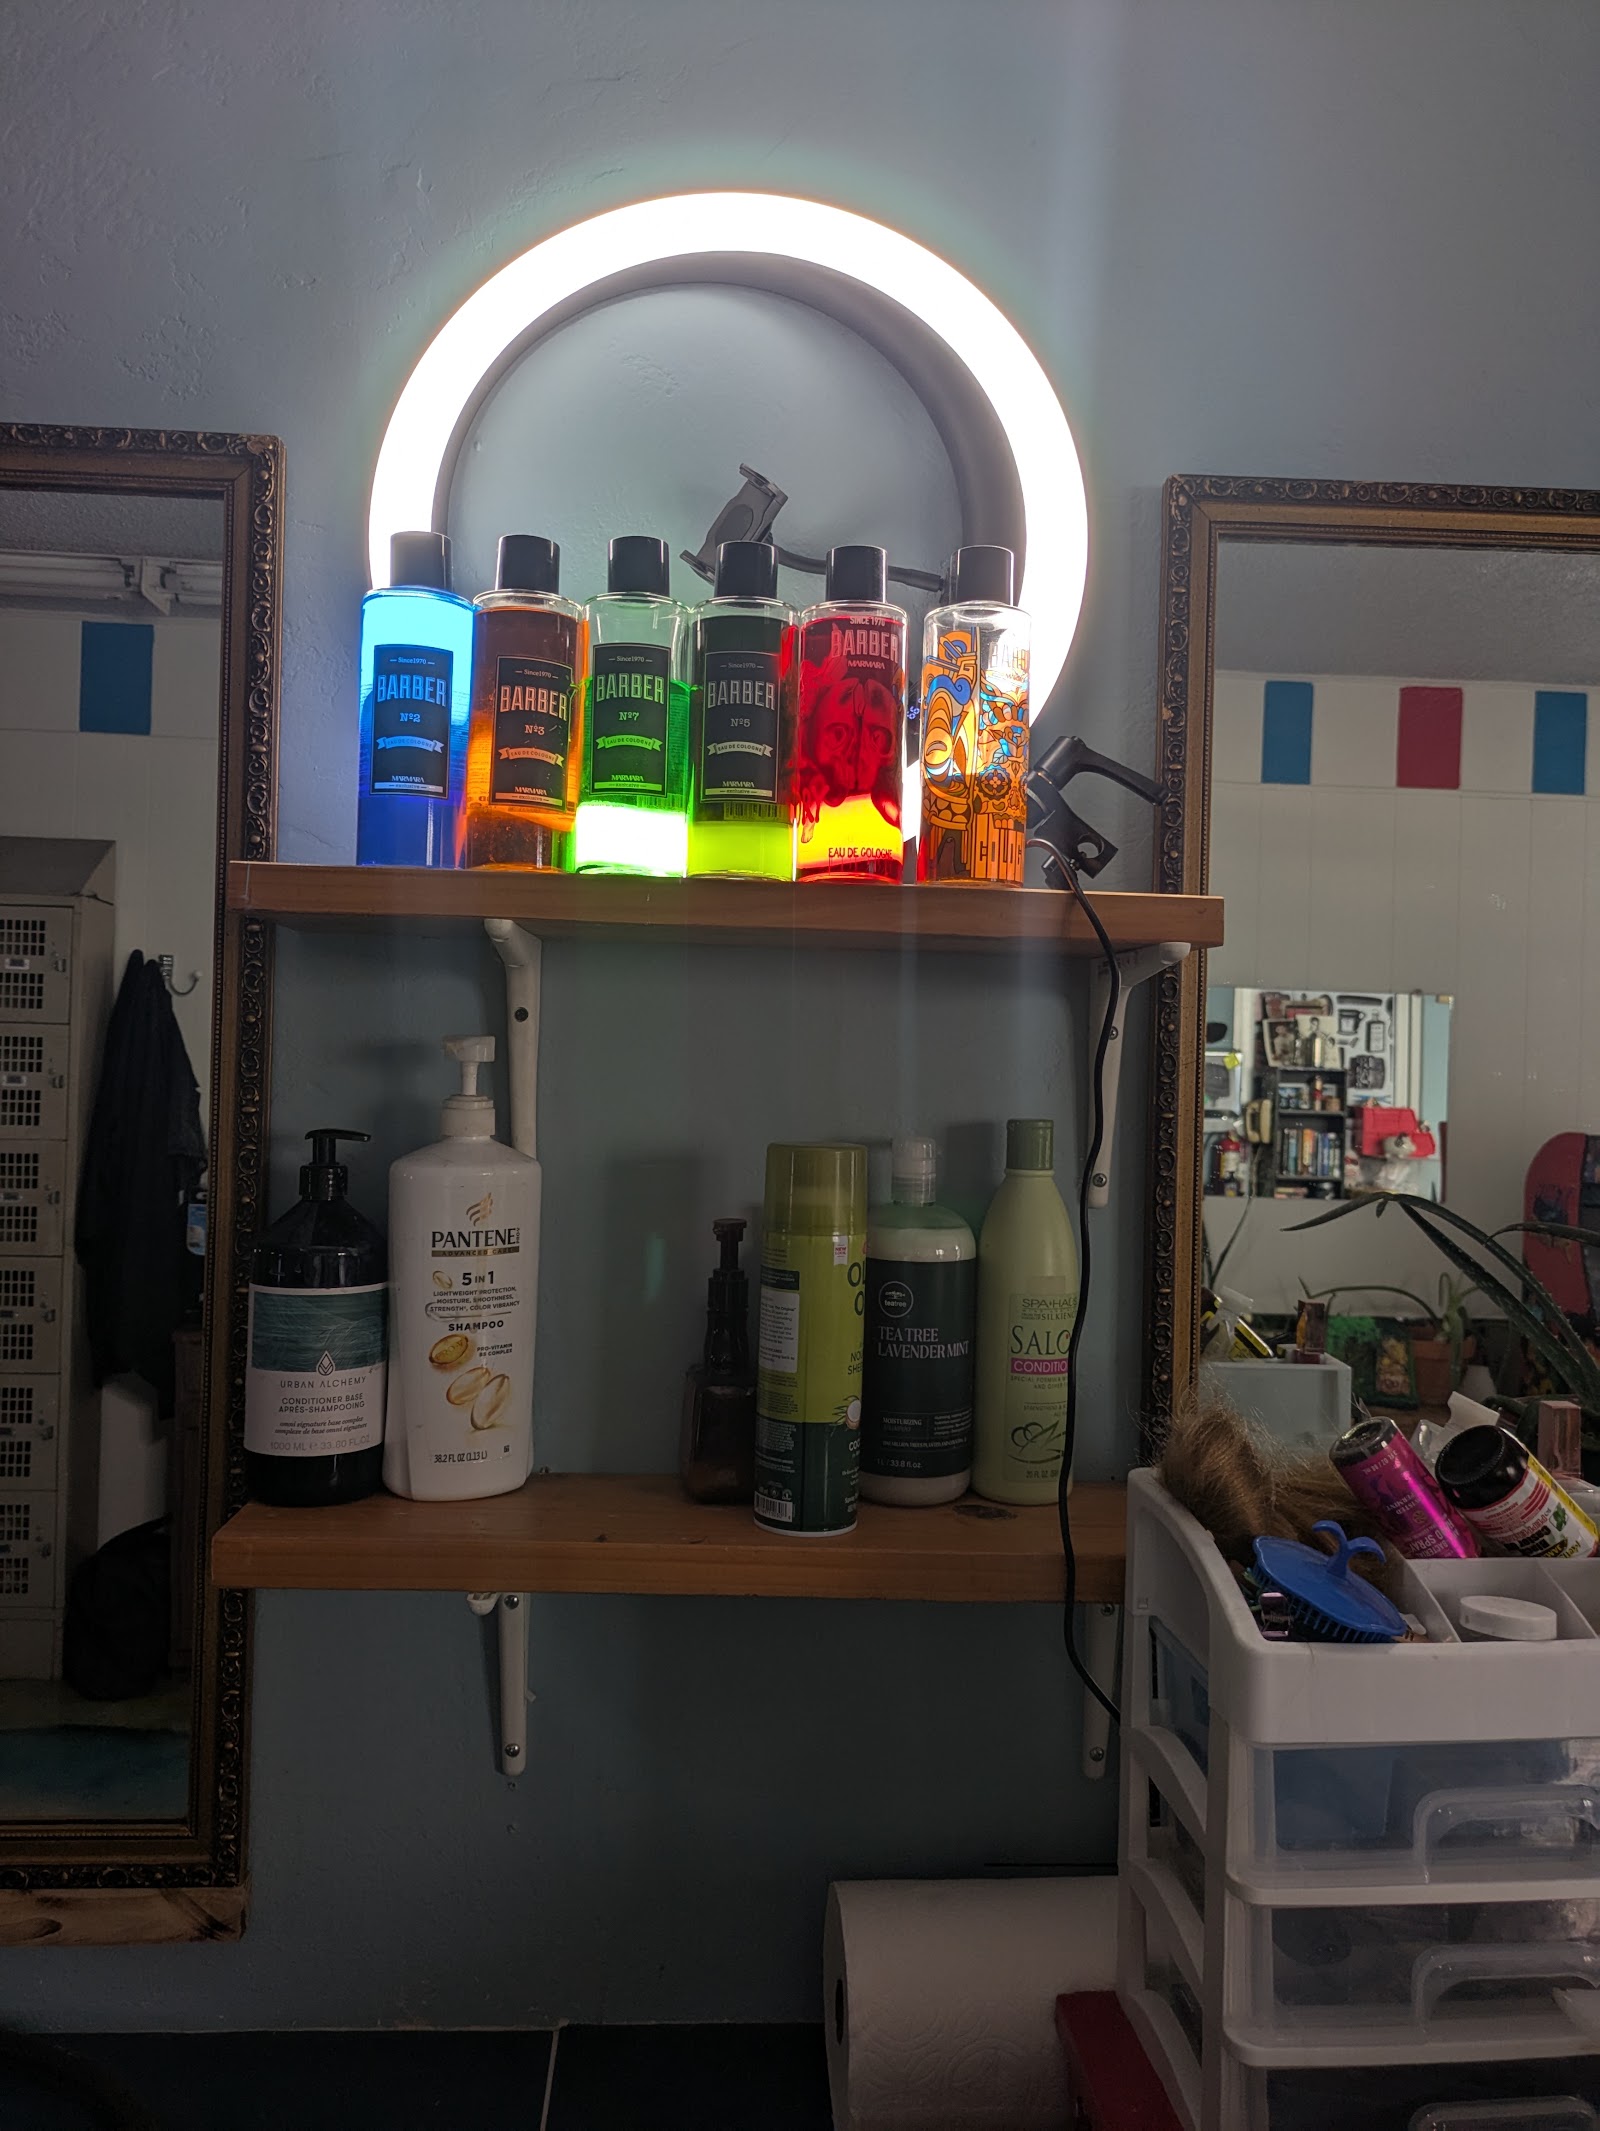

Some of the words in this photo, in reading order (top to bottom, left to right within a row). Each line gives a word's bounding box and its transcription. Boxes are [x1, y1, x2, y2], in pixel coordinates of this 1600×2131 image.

[850, 616, 870, 625] SINCE
[872, 617, 885, 626] 1970
[832, 630, 898, 663] BARBER
[848, 660, 885, 669] MARMARA
[377, 674, 446, 707] BARBER
[596, 673, 664, 704] BARBER
[708, 679, 775, 711] BARBER
[500, 685, 567, 721] BARBER
[625, 738, 652, 747] COLOGNE
[737, 744, 762, 752] COLOGNE
[531, 750, 555, 761] COLOGNE
[392, 775, 424, 783] MARMARA
[515, 786, 547, 796] MARMARA
[829, 848, 845, 857] EAU
[848, 848, 858, 857] DE
[432, 1228, 515, 1248] PANTENE
[462, 1273, 471, 1285] 5
[475, 1275, 485, 1283] IN
[488, 1271, 494, 1284] 1
[493, 1301, 520, 1309] VIBRANCY
[448, 1320, 504, 1331] SHAMPOO
[879, 1326, 903, 1341] TEA
[904, 1328, 939, 1342] TREE
[1011, 1325, 1071, 1355] SALO
[878, 1342, 945, 1359] LAVENDER
[946, 1340, 969, 1357] MINT
[1013, 1360, 1068, 1372] CONDITIO
[281, 1380, 314, 1388] URBAN
[320, 1376, 366, 1388] ALCHEMY
[282, 1396, 342, 1405] CONDITIONER
[345, 1393, 363, 1402] BASE
[882, 1417, 923, 1426] MOISTURIZING
[270, 1442, 290, 1450] 1000
[293, 1442, 306, 1451] ML
[434, 1454, 447, 1463] 38.2
[449, 1454, 455, 1462] FL
[457, 1453, 465, 1462] OZ
[890, 1460, 905, 1468] 33.8
[1518, 1525, 1551, 1547] Castor
[1408, 1534, 1436, 1552] SPRAY
